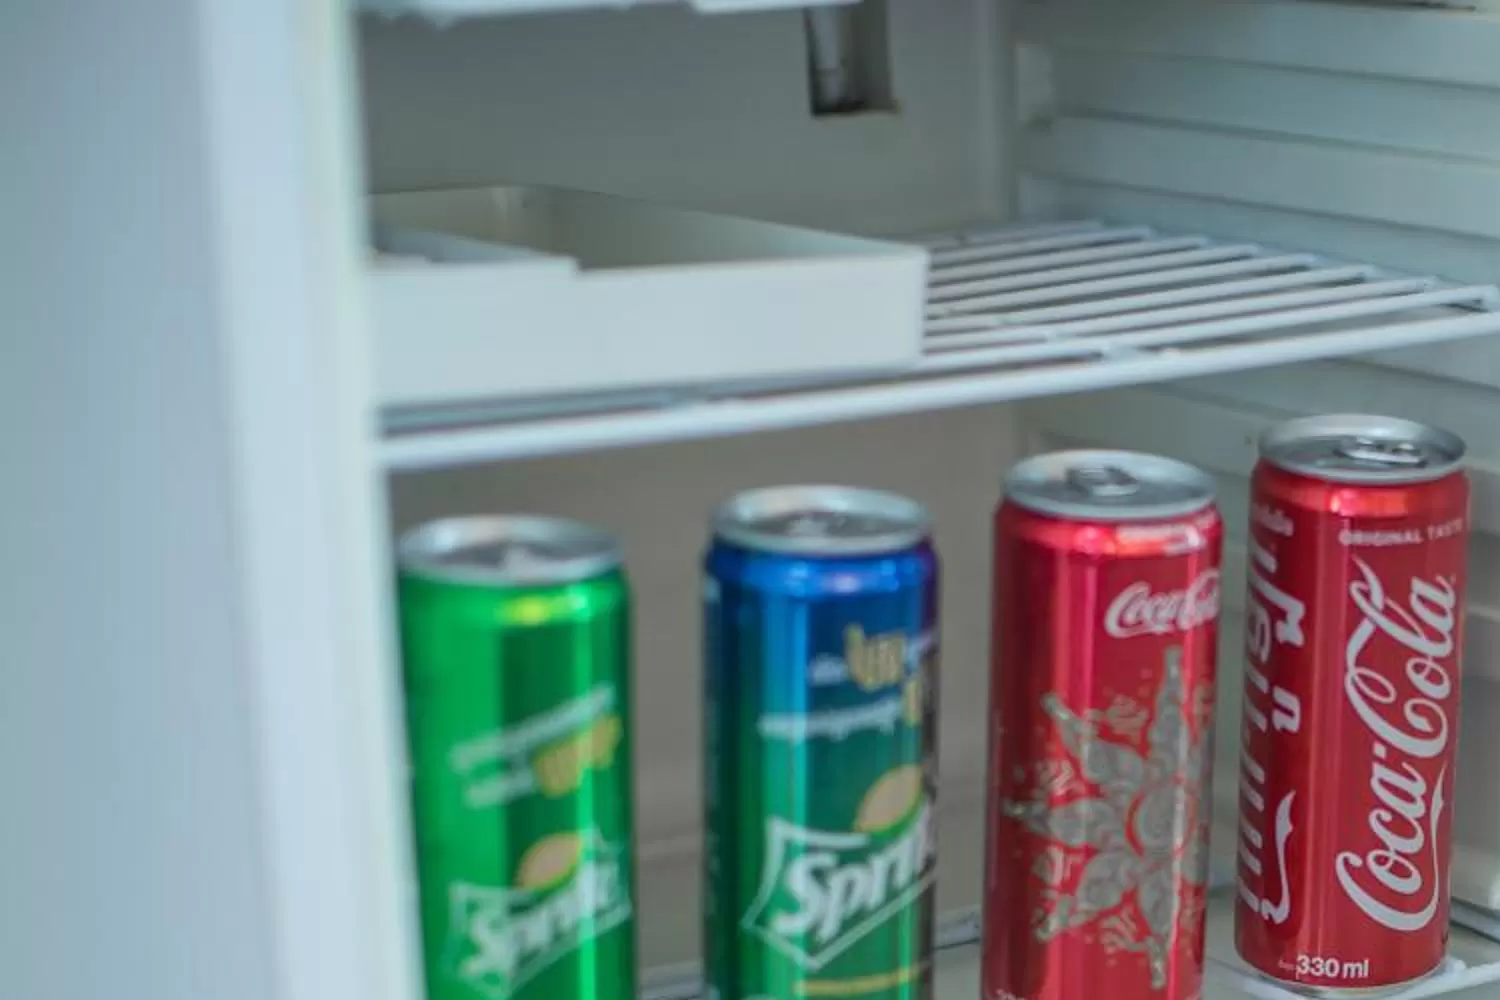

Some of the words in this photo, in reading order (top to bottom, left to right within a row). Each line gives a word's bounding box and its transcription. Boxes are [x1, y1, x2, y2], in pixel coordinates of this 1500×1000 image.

[1335, 552, 1456, 932] Coca-Cola
[1296, 954, 1339, 977] 330
[1343, 958, 1370, 979] ml
